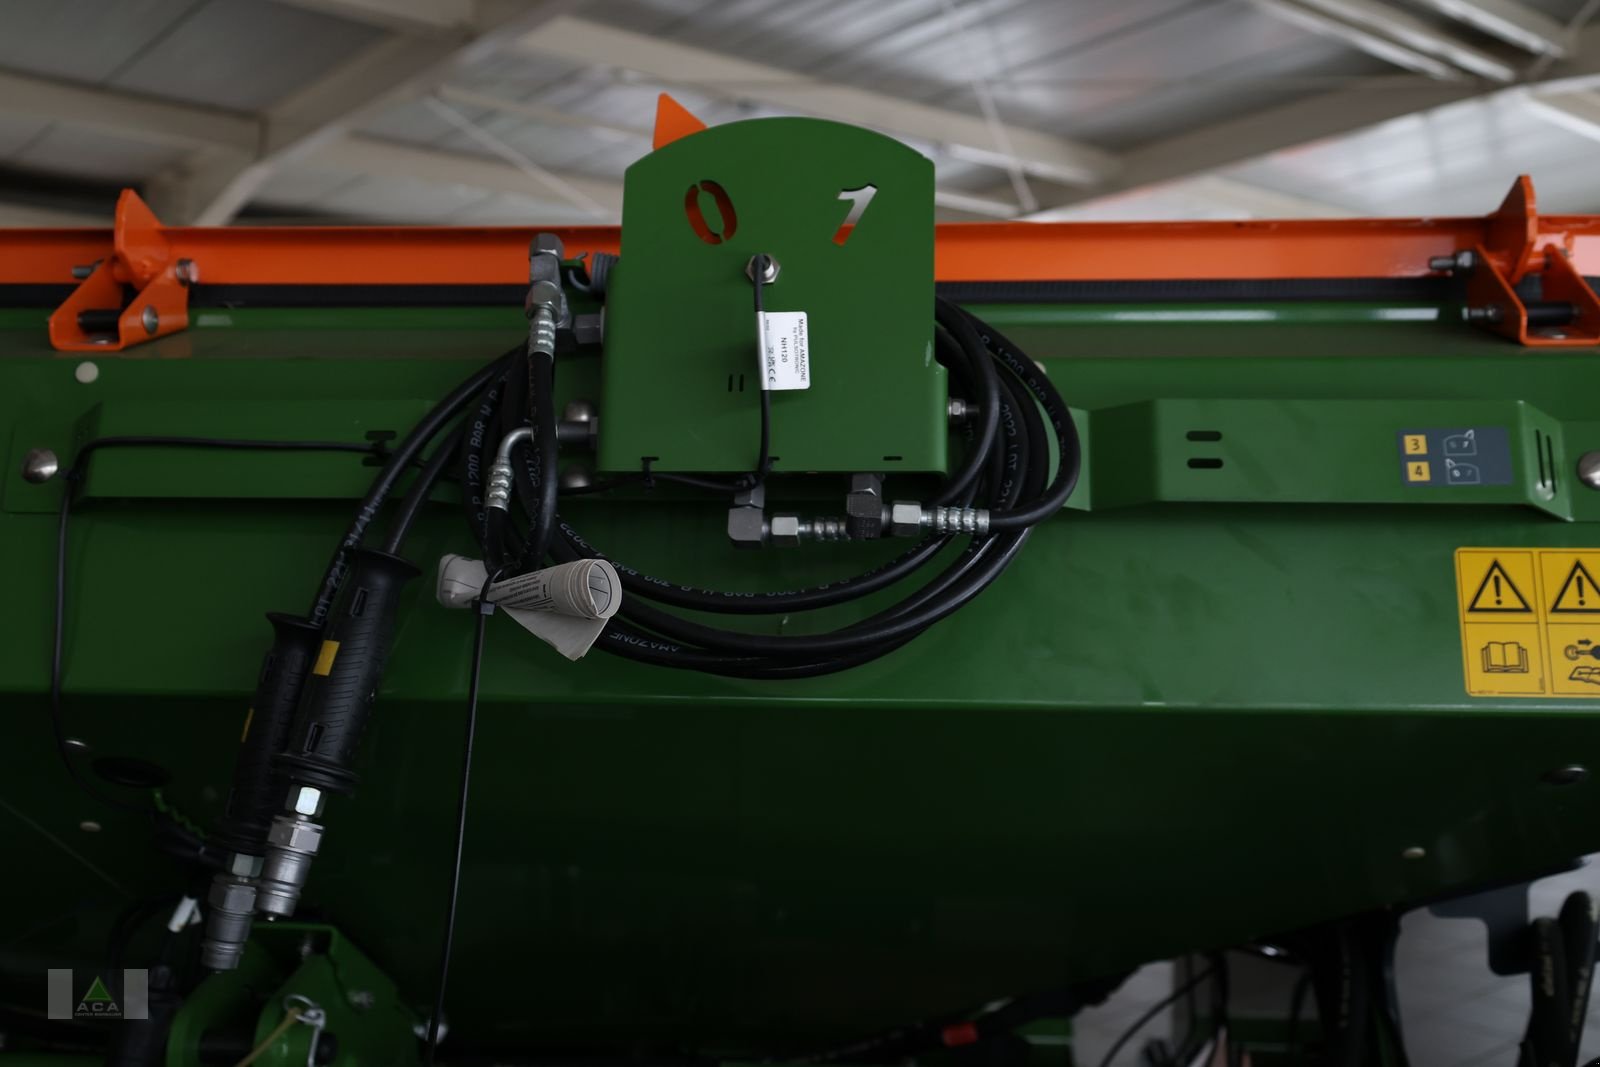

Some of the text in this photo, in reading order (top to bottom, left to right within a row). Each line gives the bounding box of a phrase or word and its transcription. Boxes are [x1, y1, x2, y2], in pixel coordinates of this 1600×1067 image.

[685, 179, 878, 247] 0 1
[470, 420, 486, 448] BAR
[1411, 438, 1420, 451] 3
[466, 452, 481, 487] 1200
[1414, 465, 1423, 477] 4
[608, 631, 681, 653] AMAZONE
